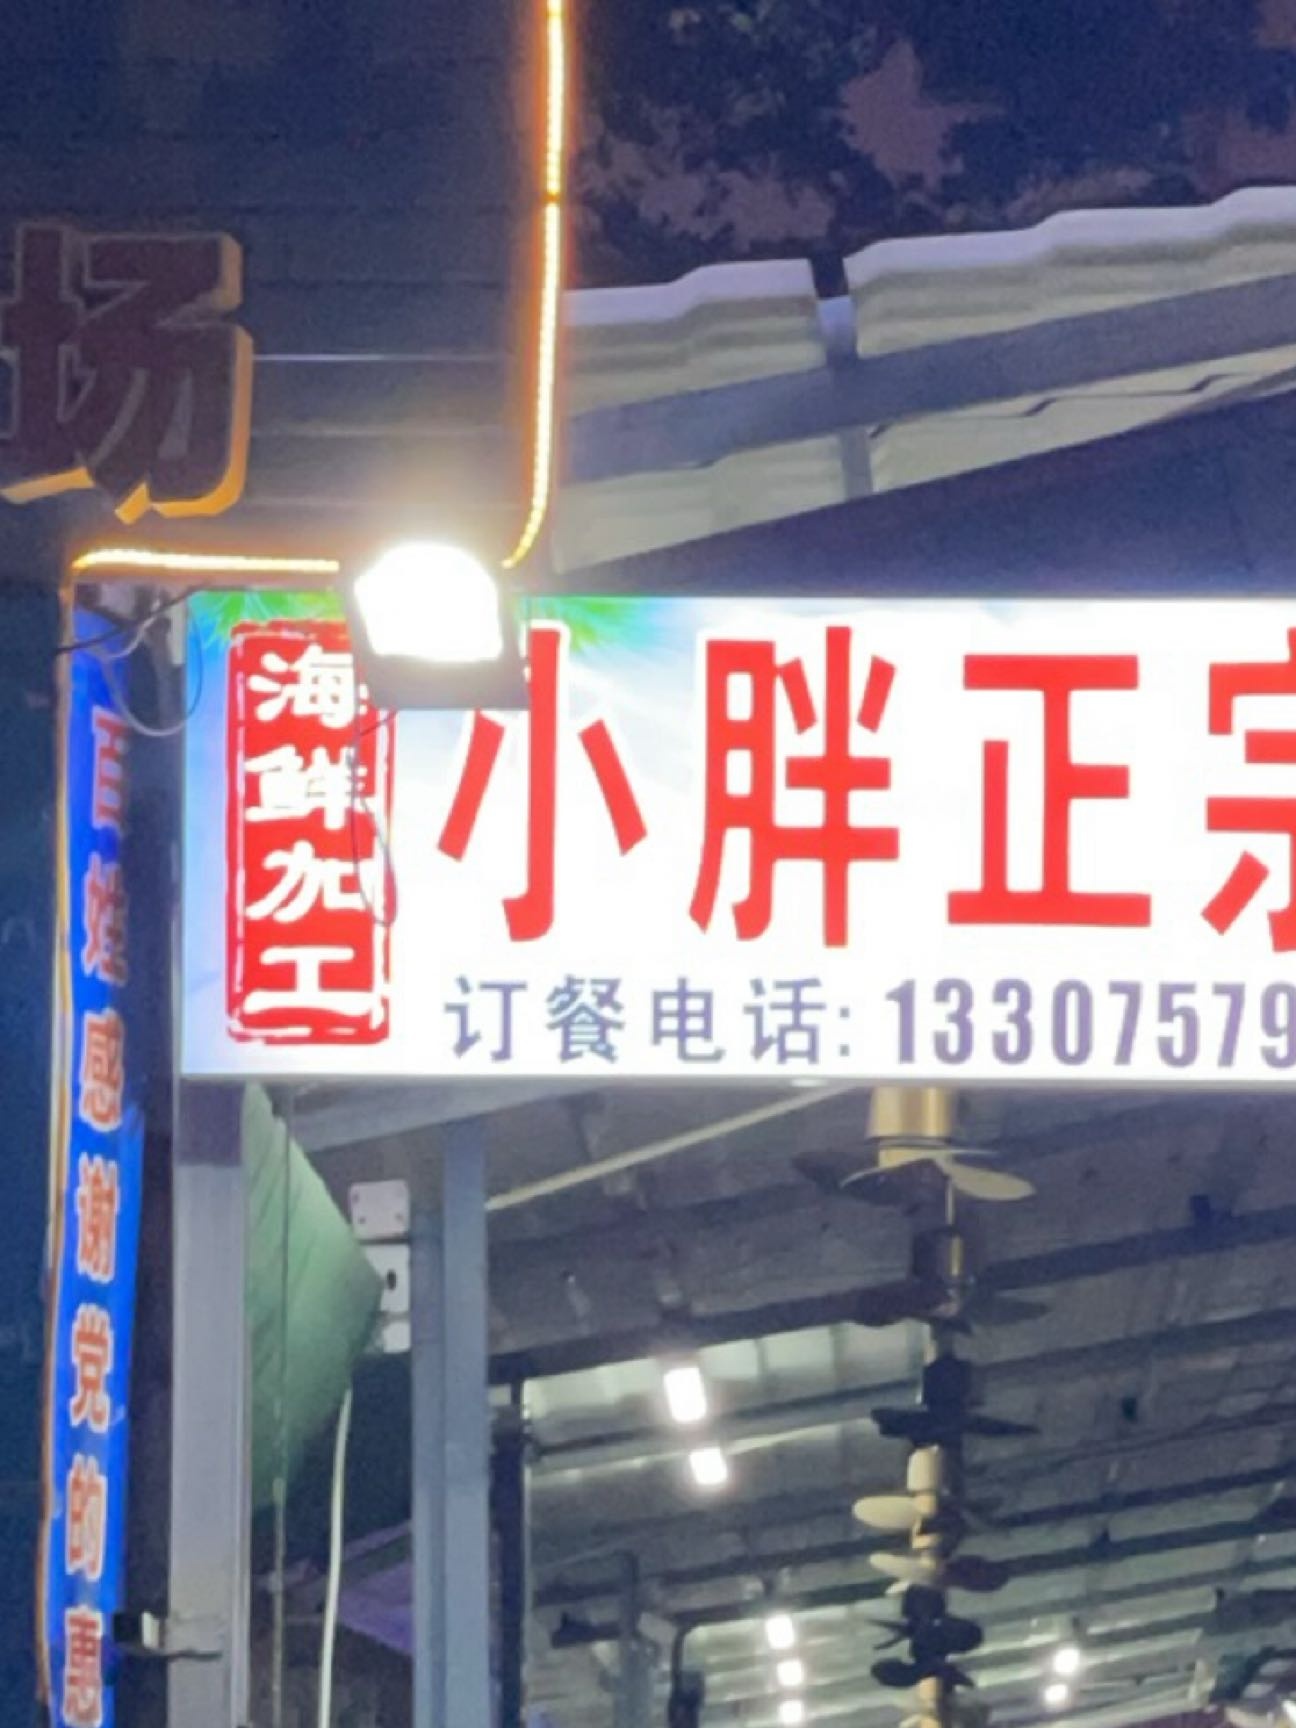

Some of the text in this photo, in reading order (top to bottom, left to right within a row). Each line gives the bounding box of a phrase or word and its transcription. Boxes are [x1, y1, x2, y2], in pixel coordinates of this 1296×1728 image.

[0, 223, 252, 525] 场
[245, 645, 380, 1016] 海鲜加工
